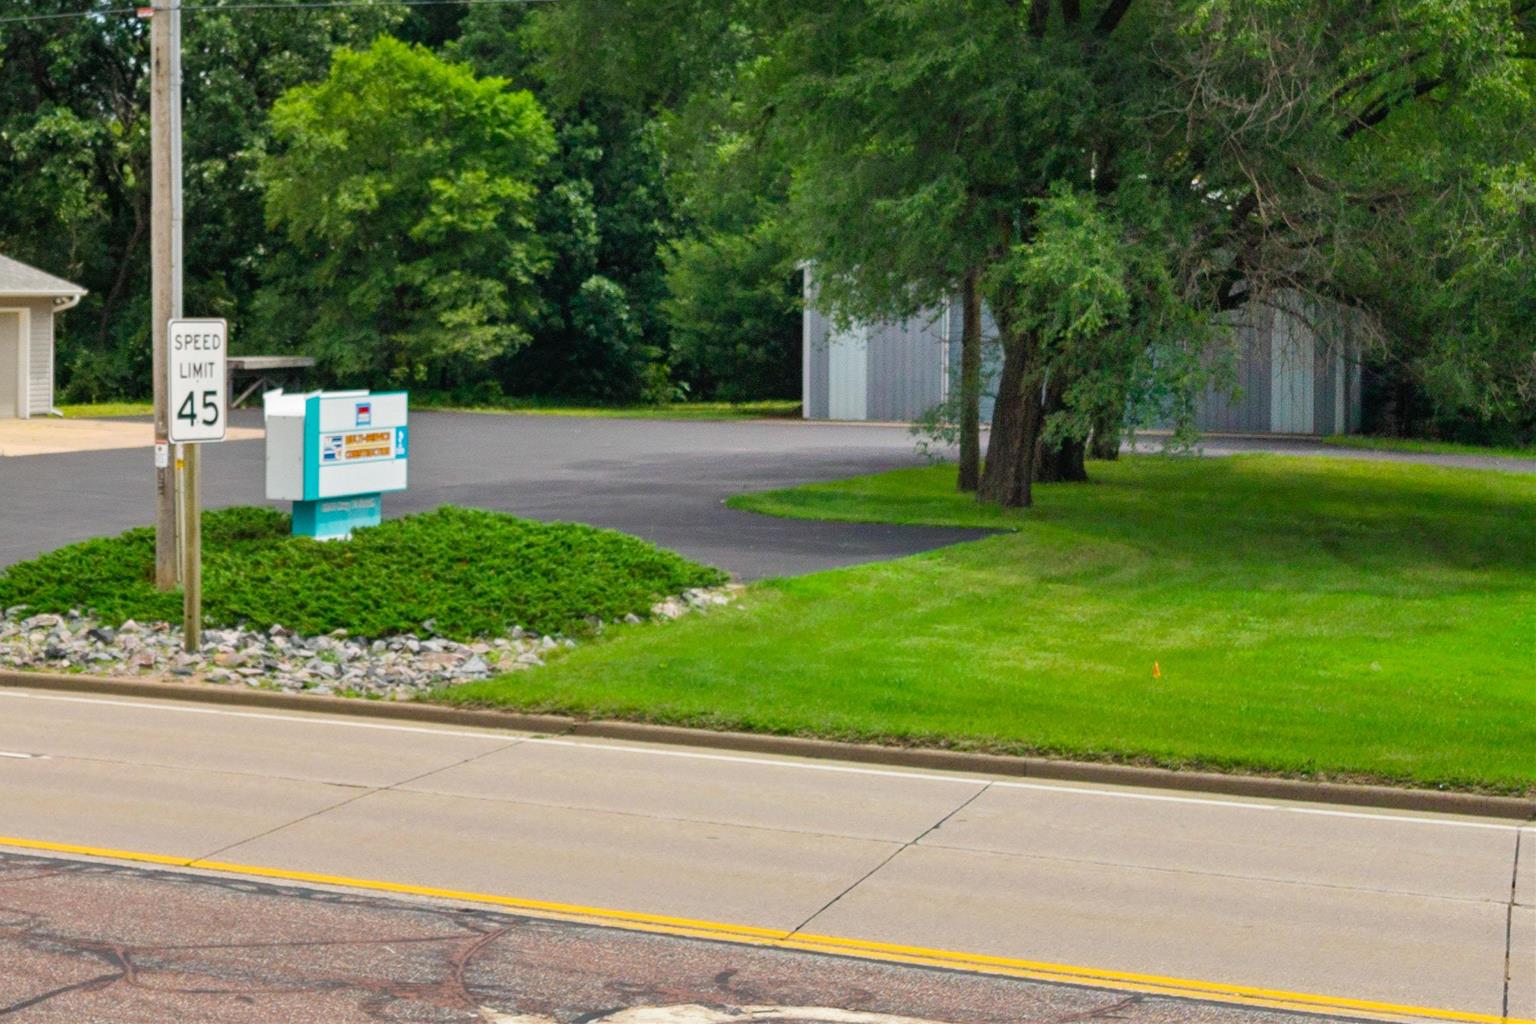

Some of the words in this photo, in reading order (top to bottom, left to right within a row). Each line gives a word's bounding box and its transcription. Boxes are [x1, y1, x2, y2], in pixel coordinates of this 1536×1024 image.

[175, 334, 221, 350] SPEED
[179, 362, 215, 379] LIMIT
[177, 390, 219, 427] 45
